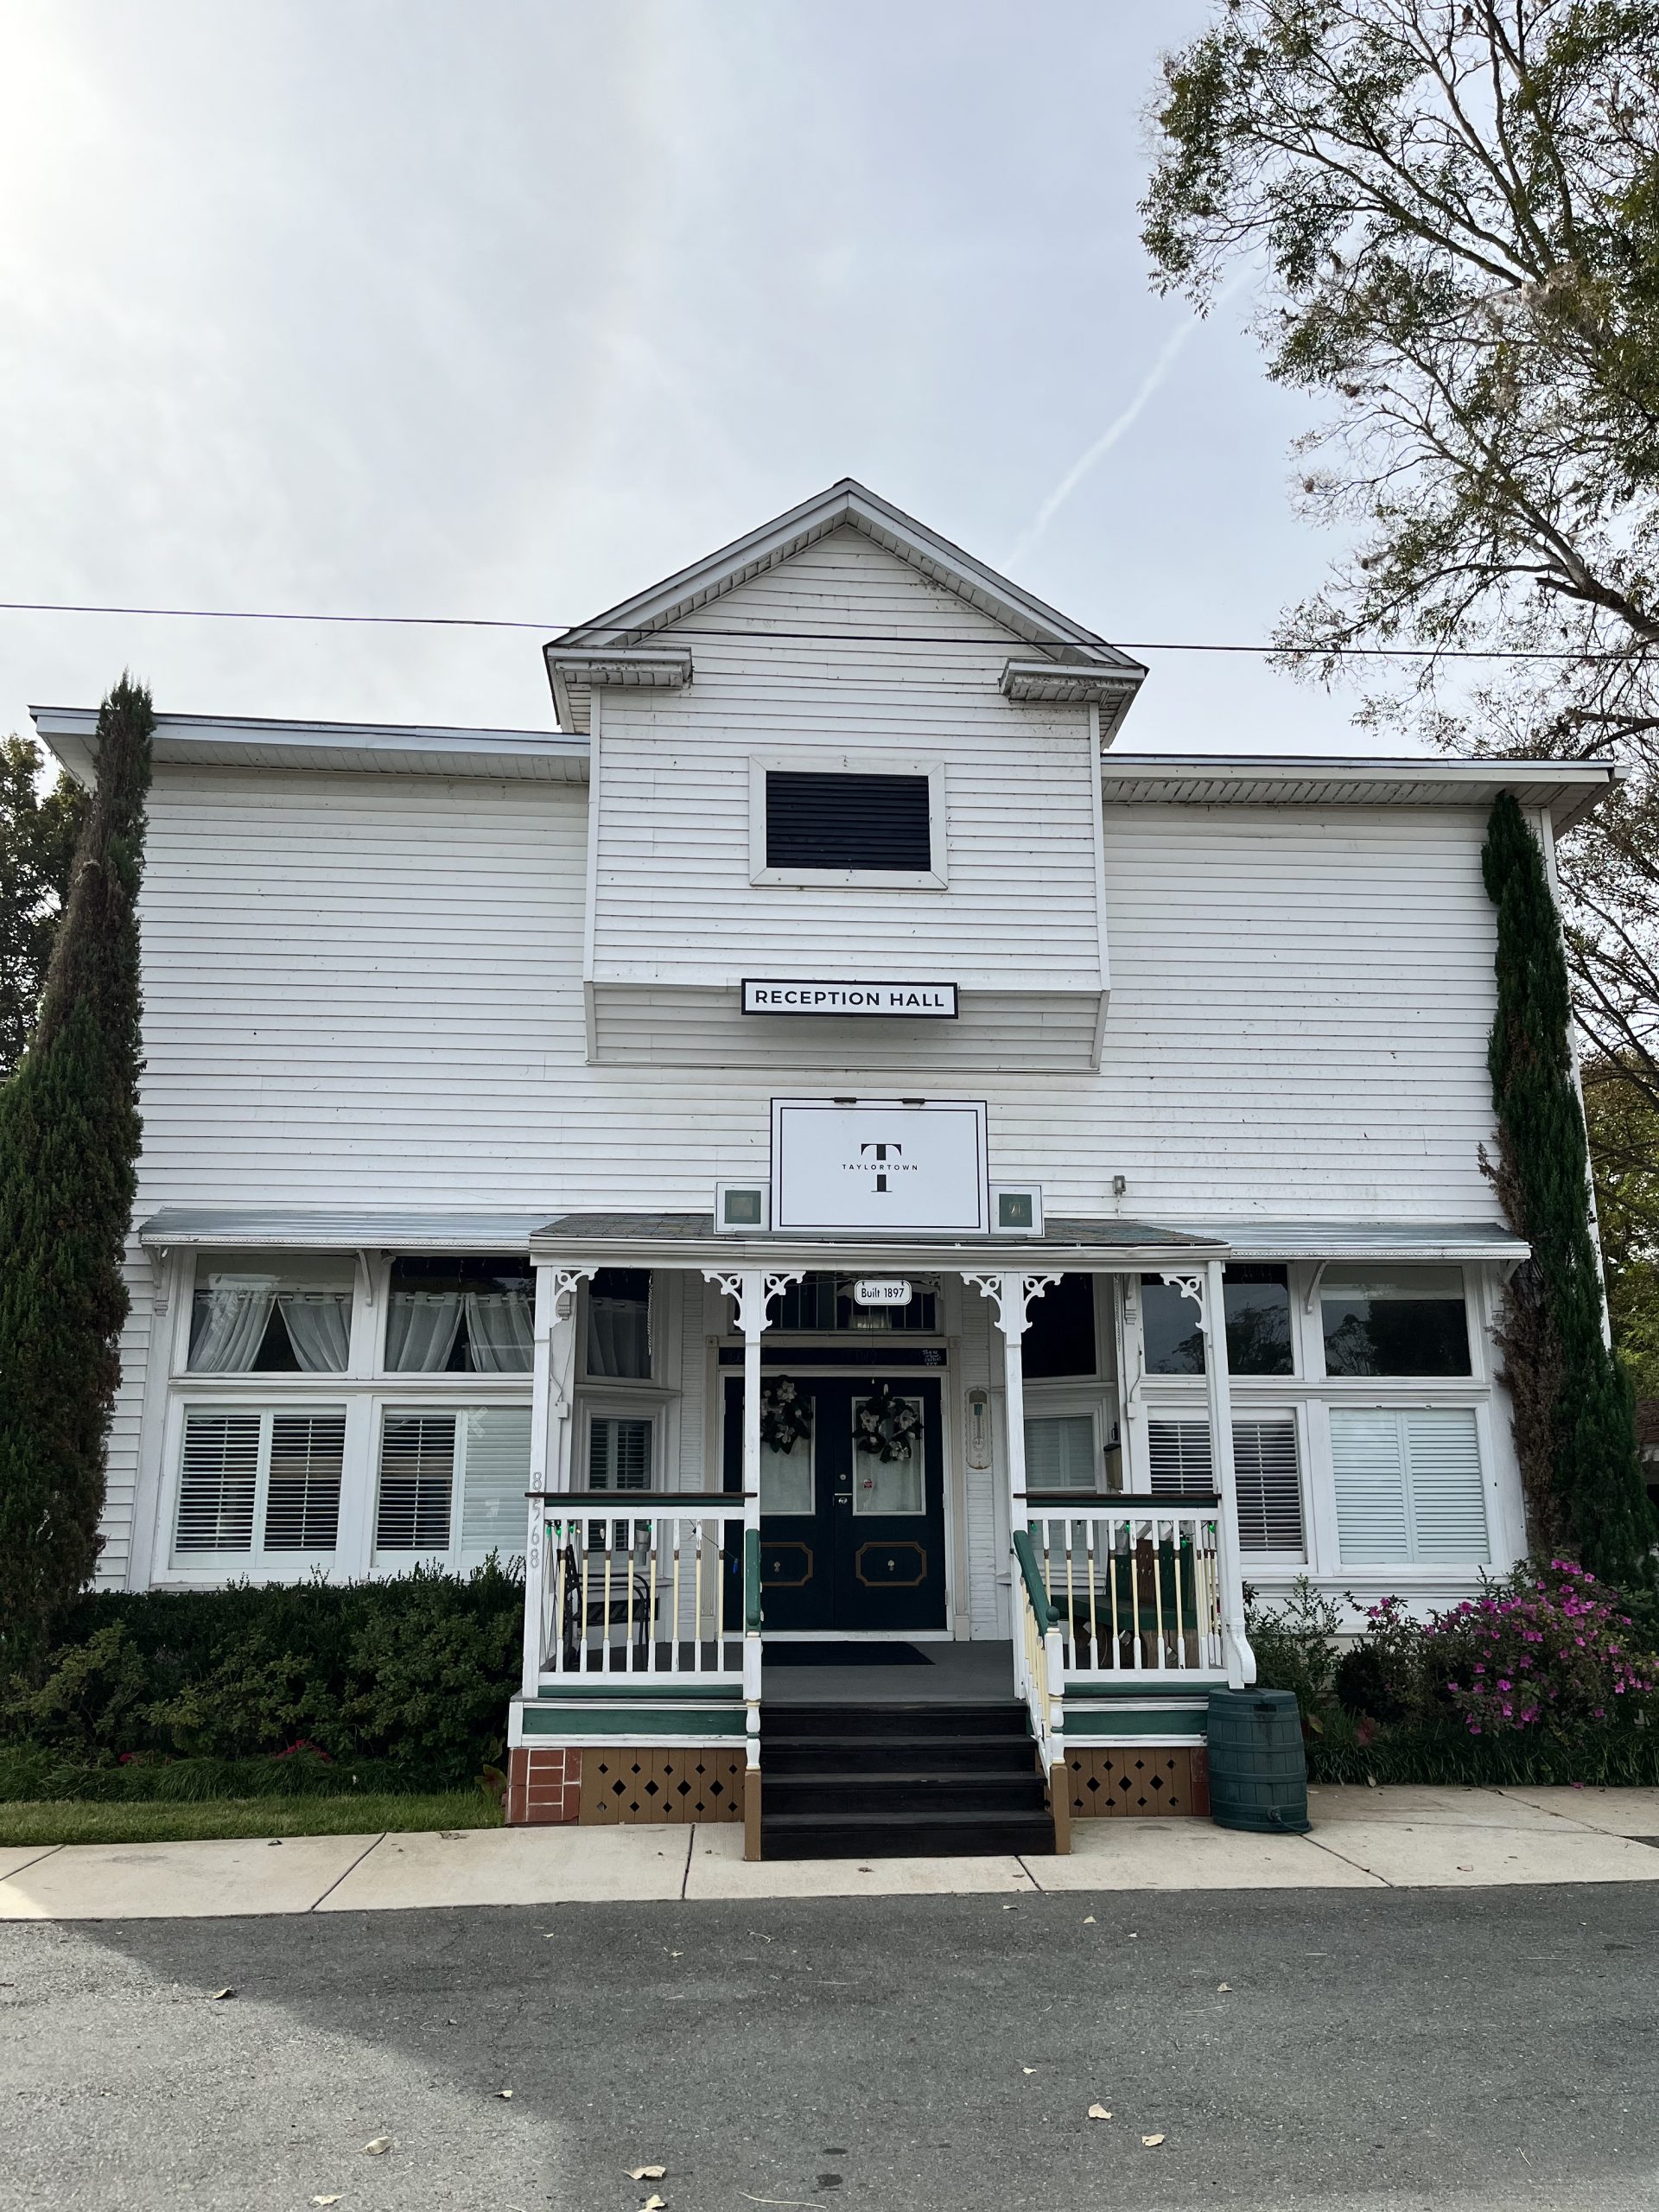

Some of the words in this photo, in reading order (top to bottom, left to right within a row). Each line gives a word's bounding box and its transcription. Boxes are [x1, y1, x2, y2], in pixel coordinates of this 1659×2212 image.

[755, 990, 880, 1006] RECEPTION
[890, 993, 944, 1007] HALL
[861, 1287, 880, 1298] Built
[884, 1287, 905, 1298] 1897
